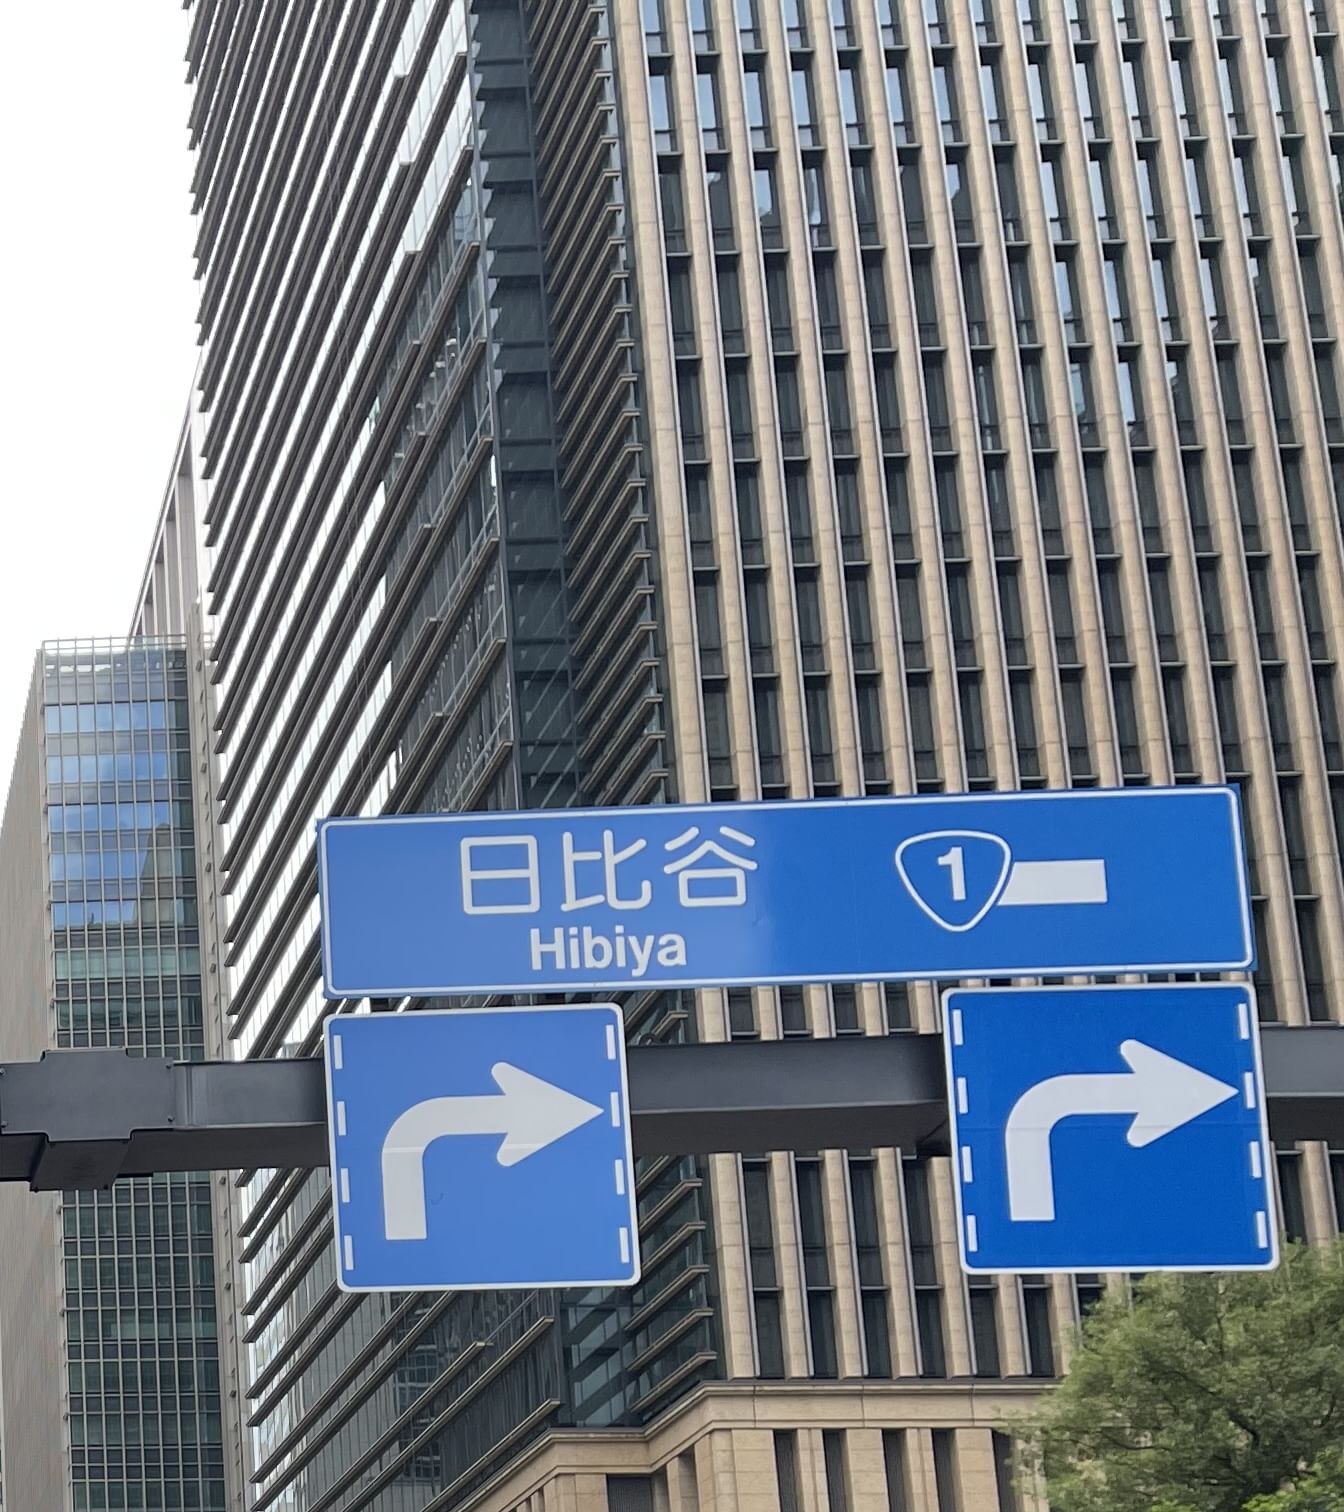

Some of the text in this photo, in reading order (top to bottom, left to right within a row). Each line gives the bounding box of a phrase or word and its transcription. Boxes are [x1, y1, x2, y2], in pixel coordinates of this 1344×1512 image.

[460, 825, 759, 916] 日比谷
[936, 846, 966, 902] 1
[529, 927, 688, 978] Hibiya
